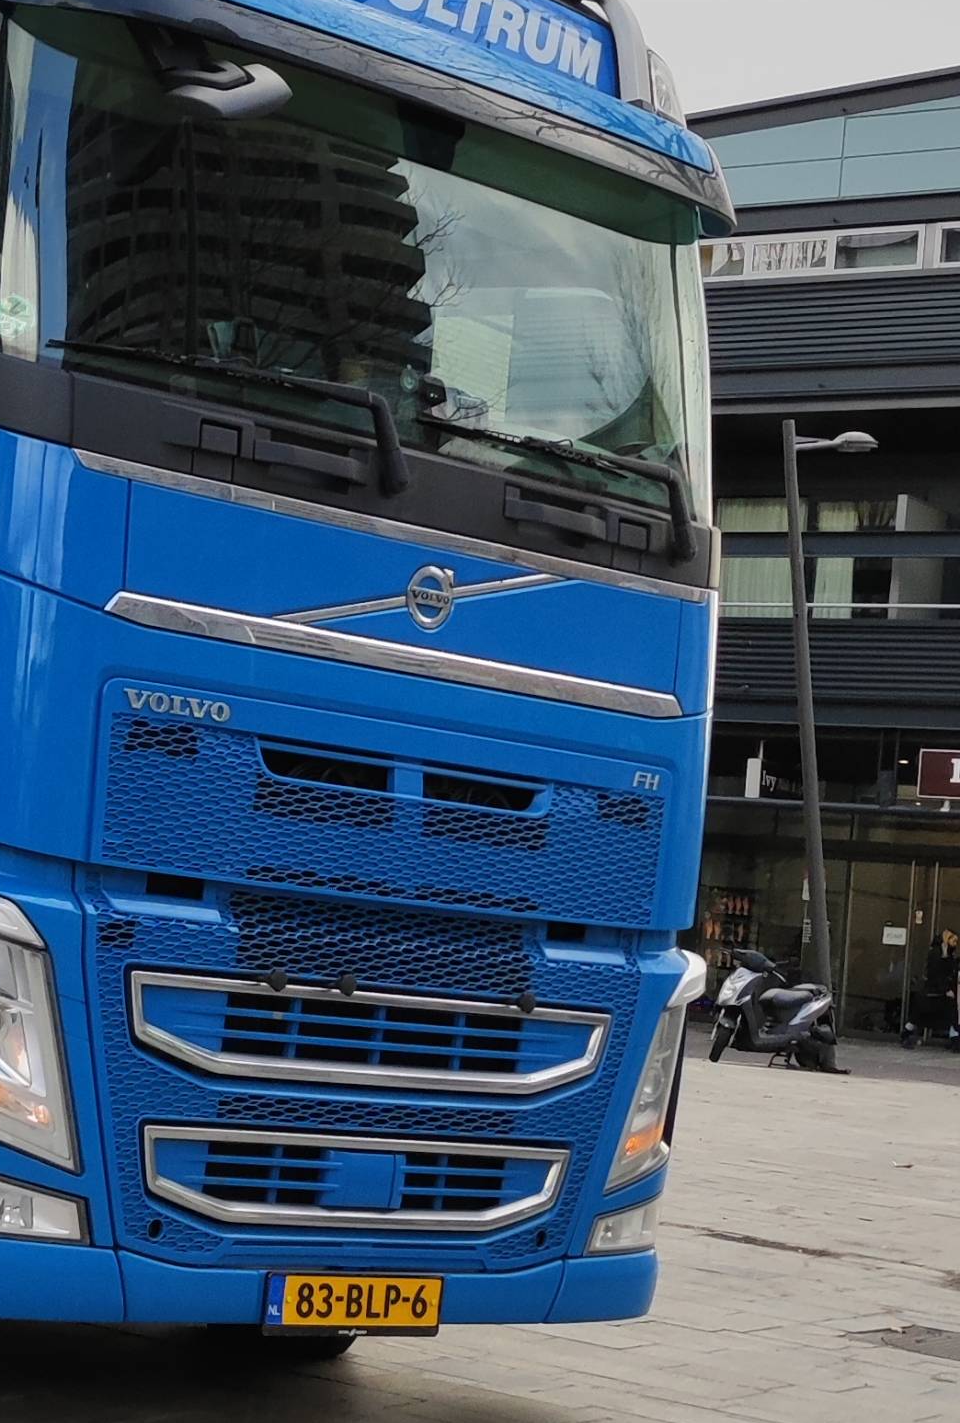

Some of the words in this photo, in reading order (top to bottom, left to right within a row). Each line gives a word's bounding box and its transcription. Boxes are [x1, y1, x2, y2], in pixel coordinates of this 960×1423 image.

[412, 589, 450, 605] VOLVO
[123, 687, 231, 723] VOLVO
[632, 771, 660, 791] FH
[267, 1304, 280, 1316] NL
[295, 1282, 428, 1319] 83-BLP-6
